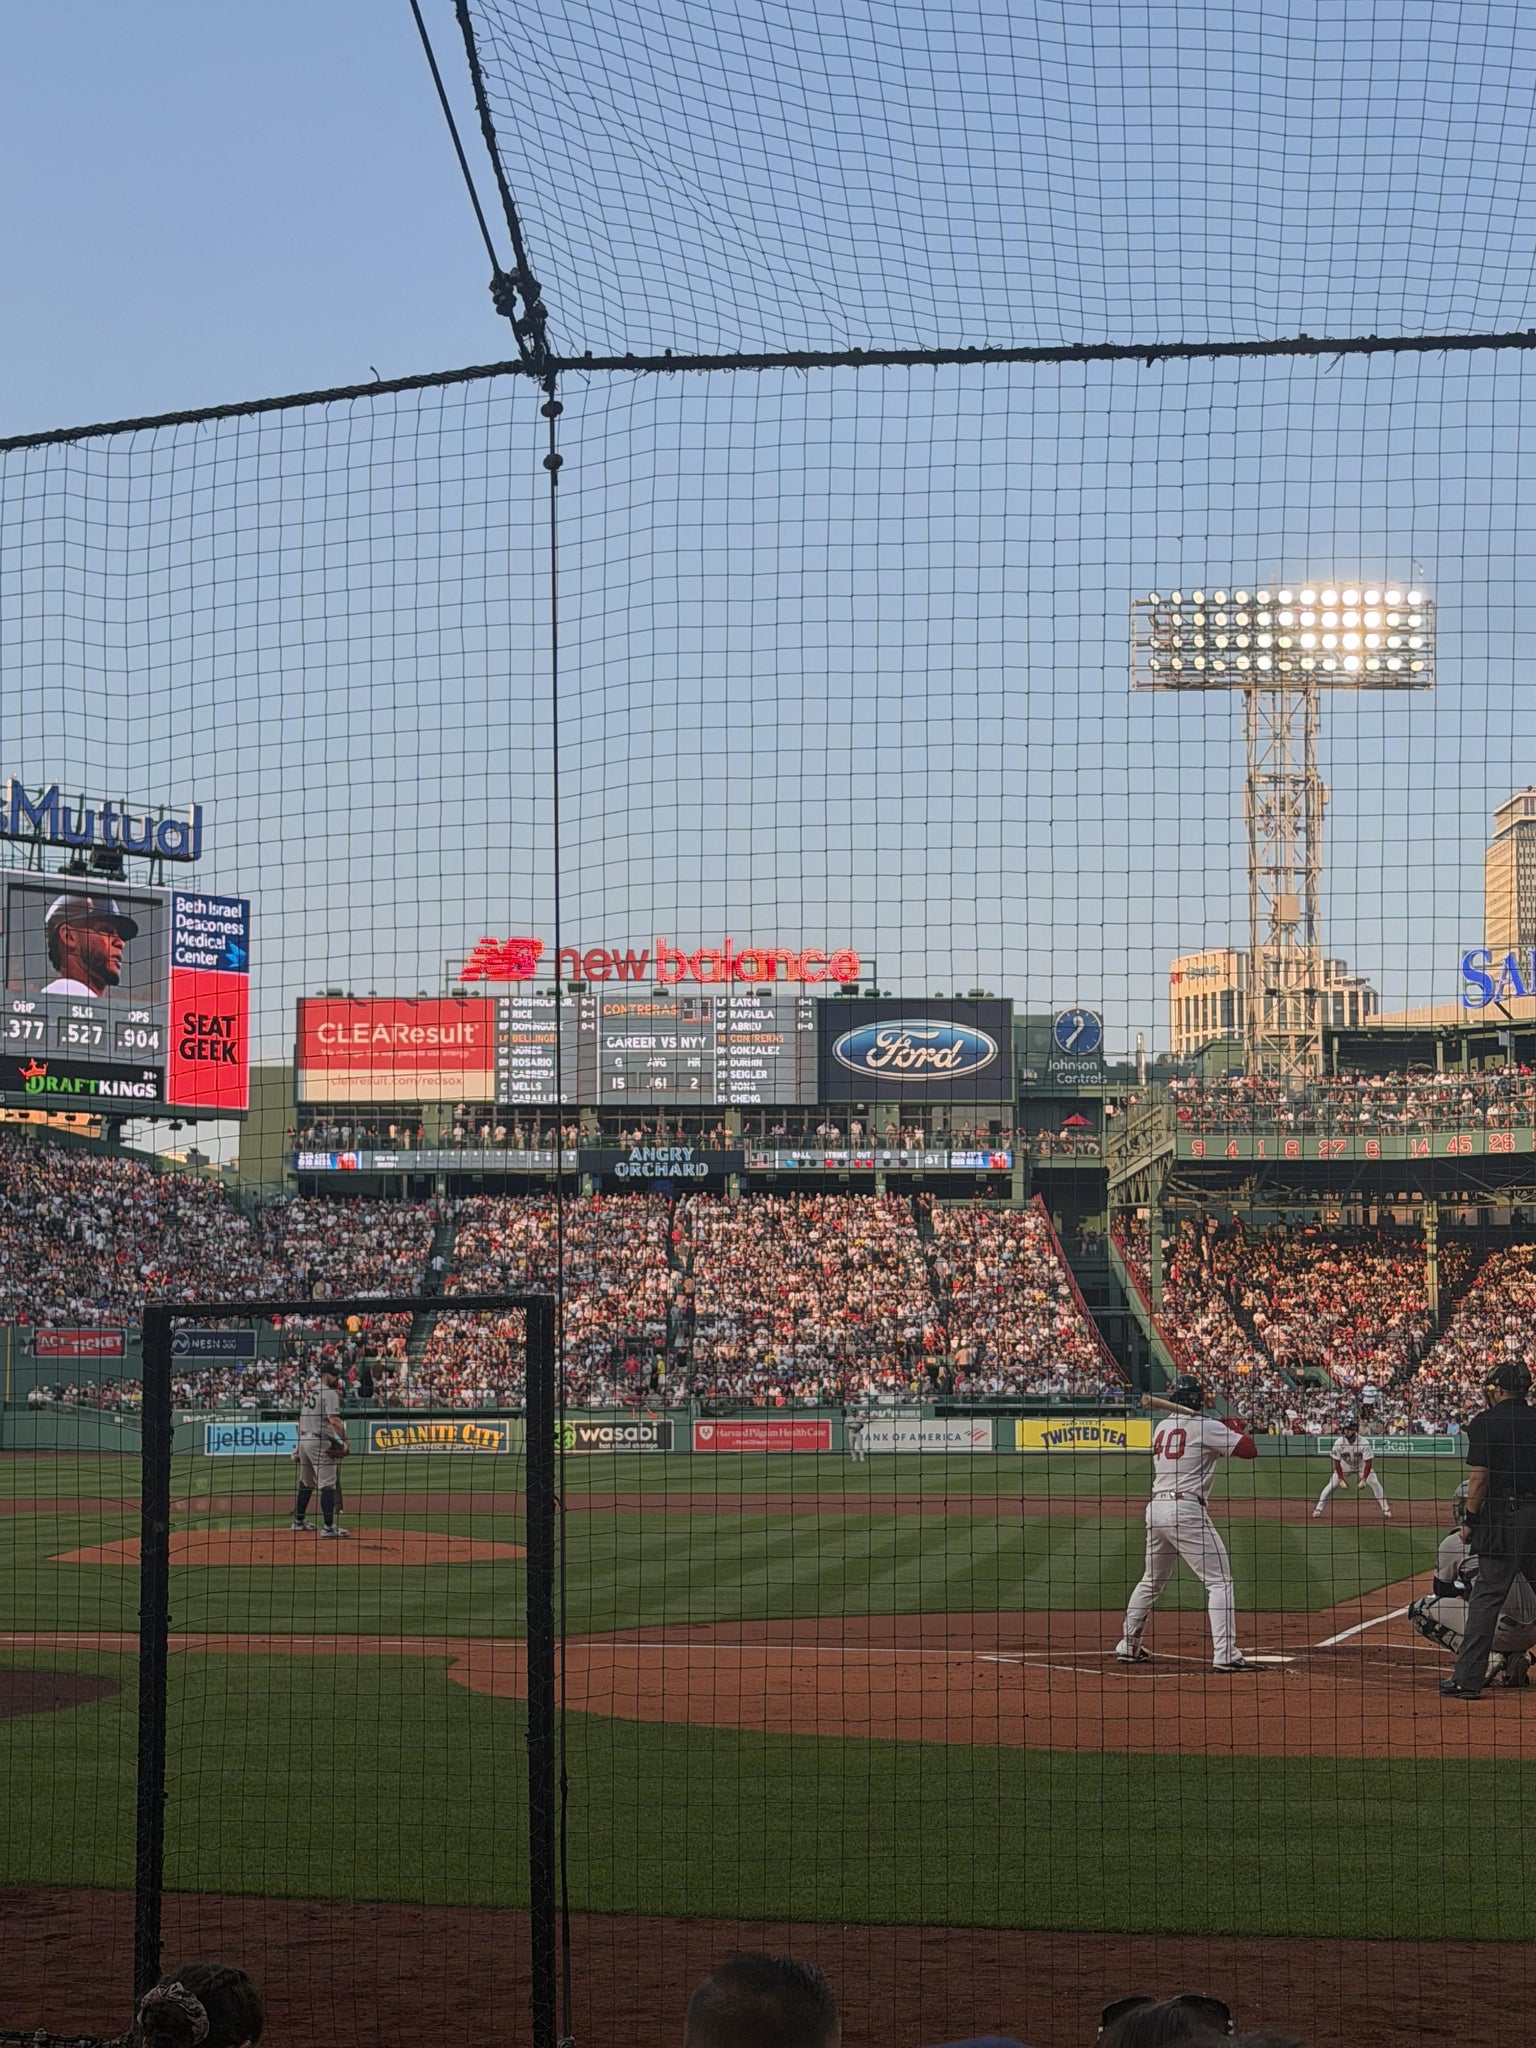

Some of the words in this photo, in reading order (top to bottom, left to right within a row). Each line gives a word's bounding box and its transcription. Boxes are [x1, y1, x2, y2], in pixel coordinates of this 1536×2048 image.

[6, 778, 202, 860] Mutual
[176, 897, 206, 915] Beth
[209, 900, 242, 918] Israel
[176, 914, 244, 935] Deaconess
[176, 931, 226, 949] Medical
[176, 949, 219, 965] Center
[560, 948, 648, 980] new
[656, 936, 861, 983] balance
[1462, 948, 1536, 1009] SA
[730, 998, 760, 1007] EATON
[72, 1006, 93, 1018] SLG
[129, 1011, 149, 1023] OPS
[512, 1010, 533, 1019] RICE
[603, 1004, 677, 1016] CONTRERAS
[730, 1010, 774, 1019] RAFAELA
[3, 1019, 44, 1040] .377
[183, 1012, 236, 1038] SEAT
[730, 1022, 761, 1031] ABREU
[62, 1024, 102, 1045] .527
[118, 1028, 159, 1049] .904
[317, 1022, 475, 1044] CLEAResult
[512, 1034, 557, 1043] BELLINGE
[606, 1036, 656, 1048] CAREER
[661, 1036, 677, 1048] VS
[681, 1036, 706, 1048] NYY
[866, 1029, 963, 1069] Ford
[180, 1037, 237, 1065] GEEK
[730, 1046, 780, 1055] GONZALEZ
[512, 1058, 552, 1067] ROSARIO
[647, 1057, 667, 1067] AVG
[687, 1057, 701, 1067] HR
[1048, 1058, 1098, 1072] Johnson
[730, 1070, 767, 1079] SEIGLER
[1056, 1072, 1108, 1084] Controls
[26, 1075, 157, 1098] DRAFTKINGS
[512, 1082, 542, 1091] WELLS
[612, 1077, 625, 1089] 15
[646, 1077, 667, 1089] .61
[690, 1078, 699, 1089] 2
[730, 1094, 760, 1103] CHENG
[1191, 1140, 1206, 1158] 9
[1224, 1140, 1239, 1158] 4
[1258, 1140, 1267, 1158] 1
[1285, 1140, 1299, 1158] 8
[1318, 1140, 1347, 1158] 27
[1365, 1140, 1380, 1158] 6
[1410, 1138, 1431, 1158] 14
[1446, 1135, 1472, 1154] 45
[1488, 1132, 1515, 1152] 26
[629, 1147, 694, 1161] ANGRY
[792, 1151, 811, 1159] BALL
[614, 1162, 709, 1177] ORCHARD
[71, 1335, 122, 1353] TICKET
[192, 1339, 221, 1349] NESN
[375, 1425, 459, 1448] GRANITE
[462, 1424, 504, 1448] CITY
[580, 1422, 658, 1441] wasabi
[864, 1433, 888, 1441] ANK
[893, 1433, 906, 1441] OF
[909, 1433, 962, 1441] AMERICA
[1040, 1427, 1100, 1449] TWISTED
[1102, 1428, 1127, 1448] TEA
[215, 1427, 285, 1451] jetBlue
[1153, 1428, 1187, 1461] 40
